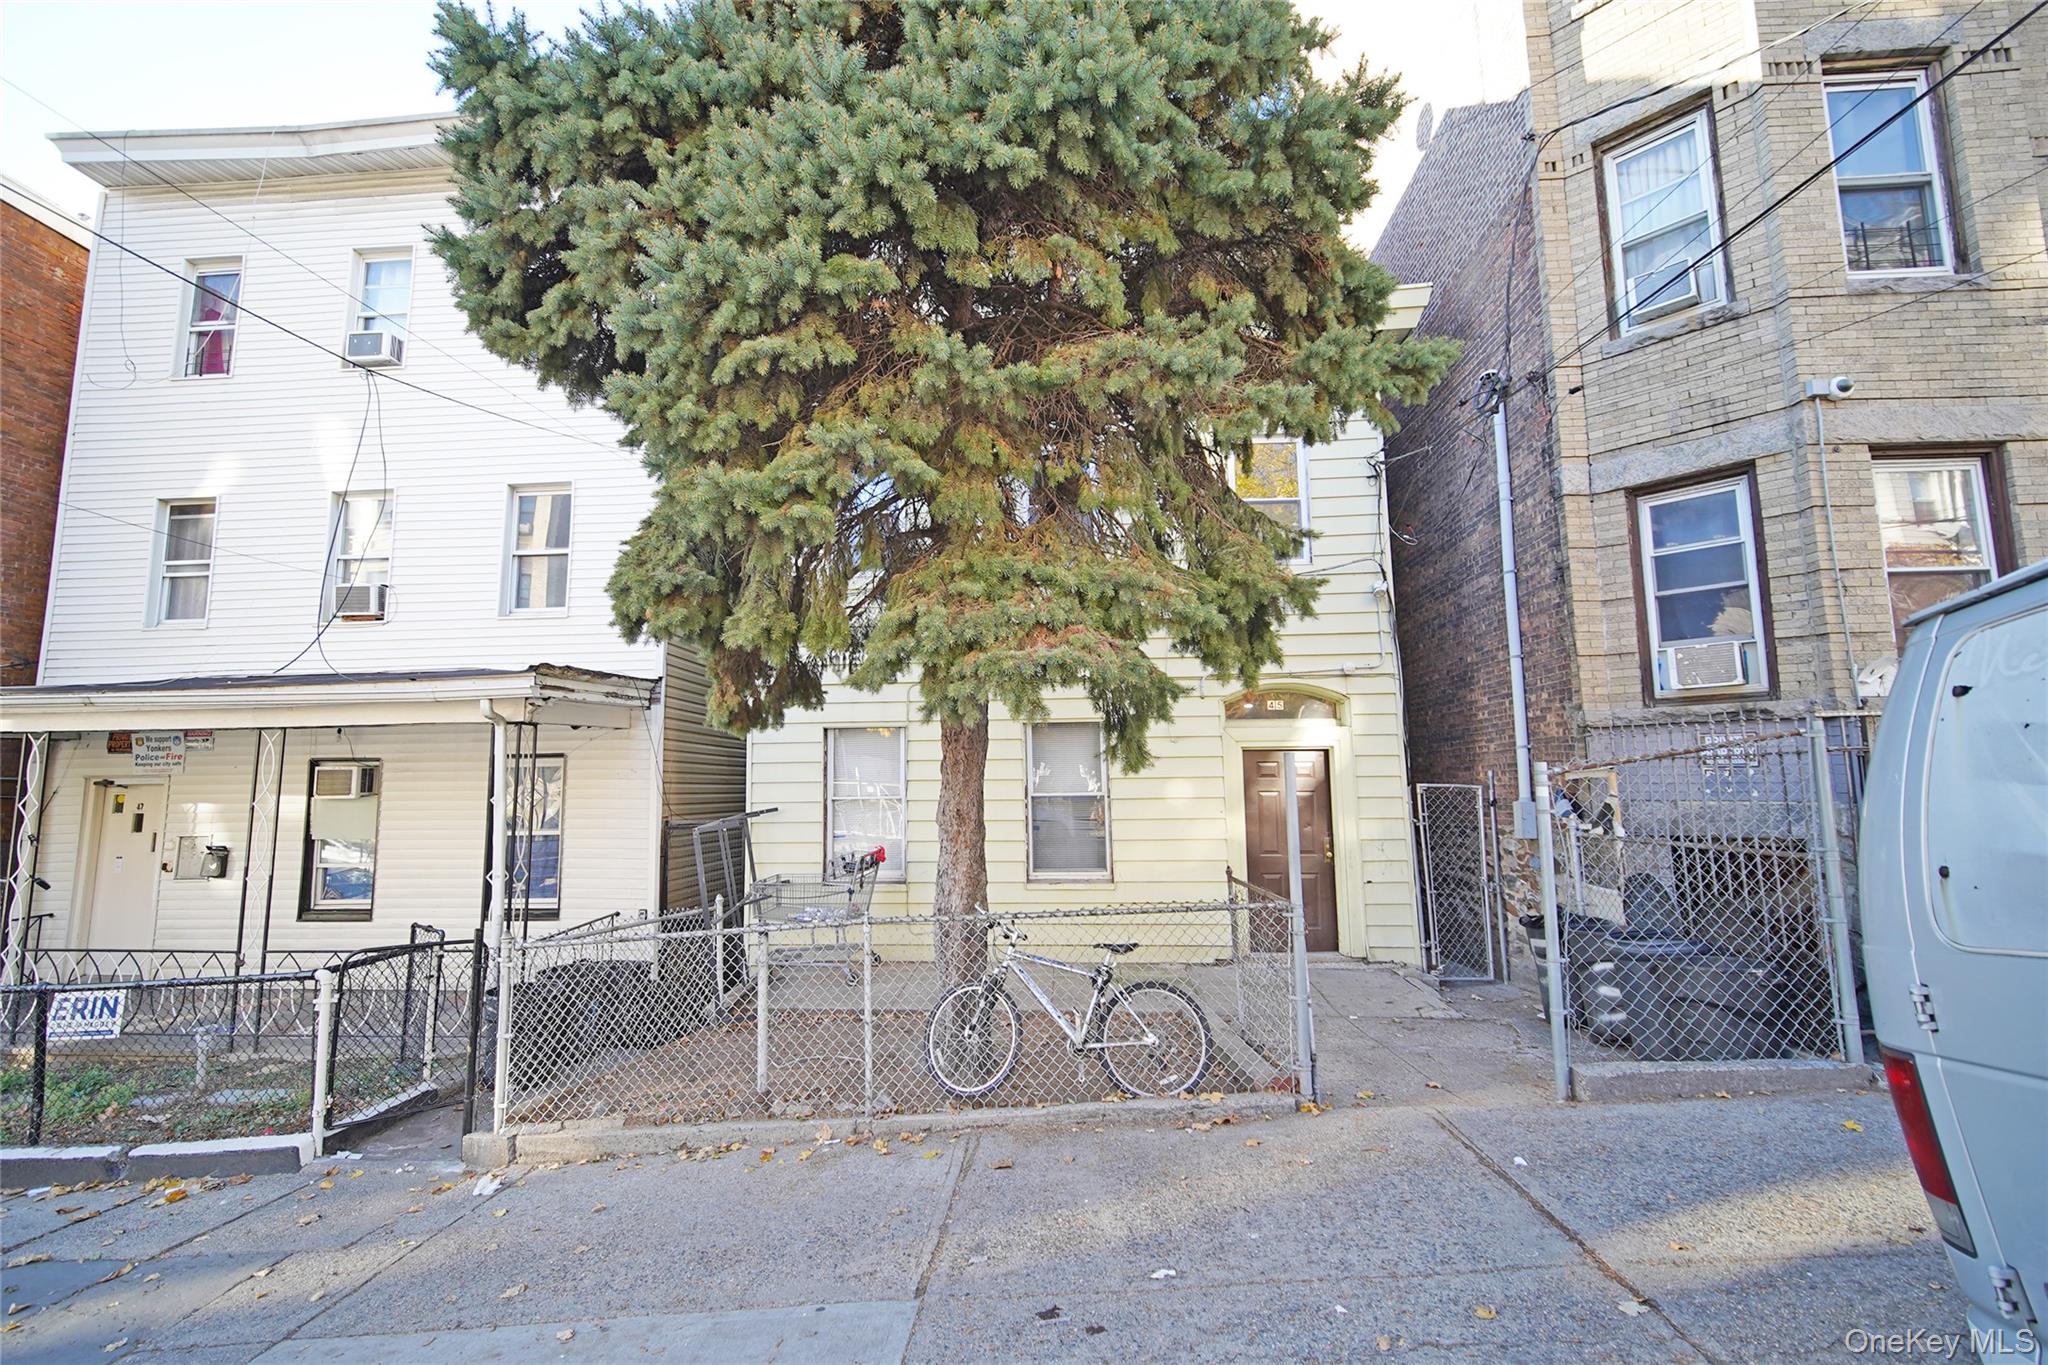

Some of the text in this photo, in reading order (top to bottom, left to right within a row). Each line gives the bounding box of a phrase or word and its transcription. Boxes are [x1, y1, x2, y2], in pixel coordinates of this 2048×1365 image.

[1268, 700, 1284, 710] 45
[146, 744, 172, 752] Yonkers
[135, 753, 160, 761] Police
[166, 752, 183, 760] Fire
[53, 996, 119, 1021] ERIN
